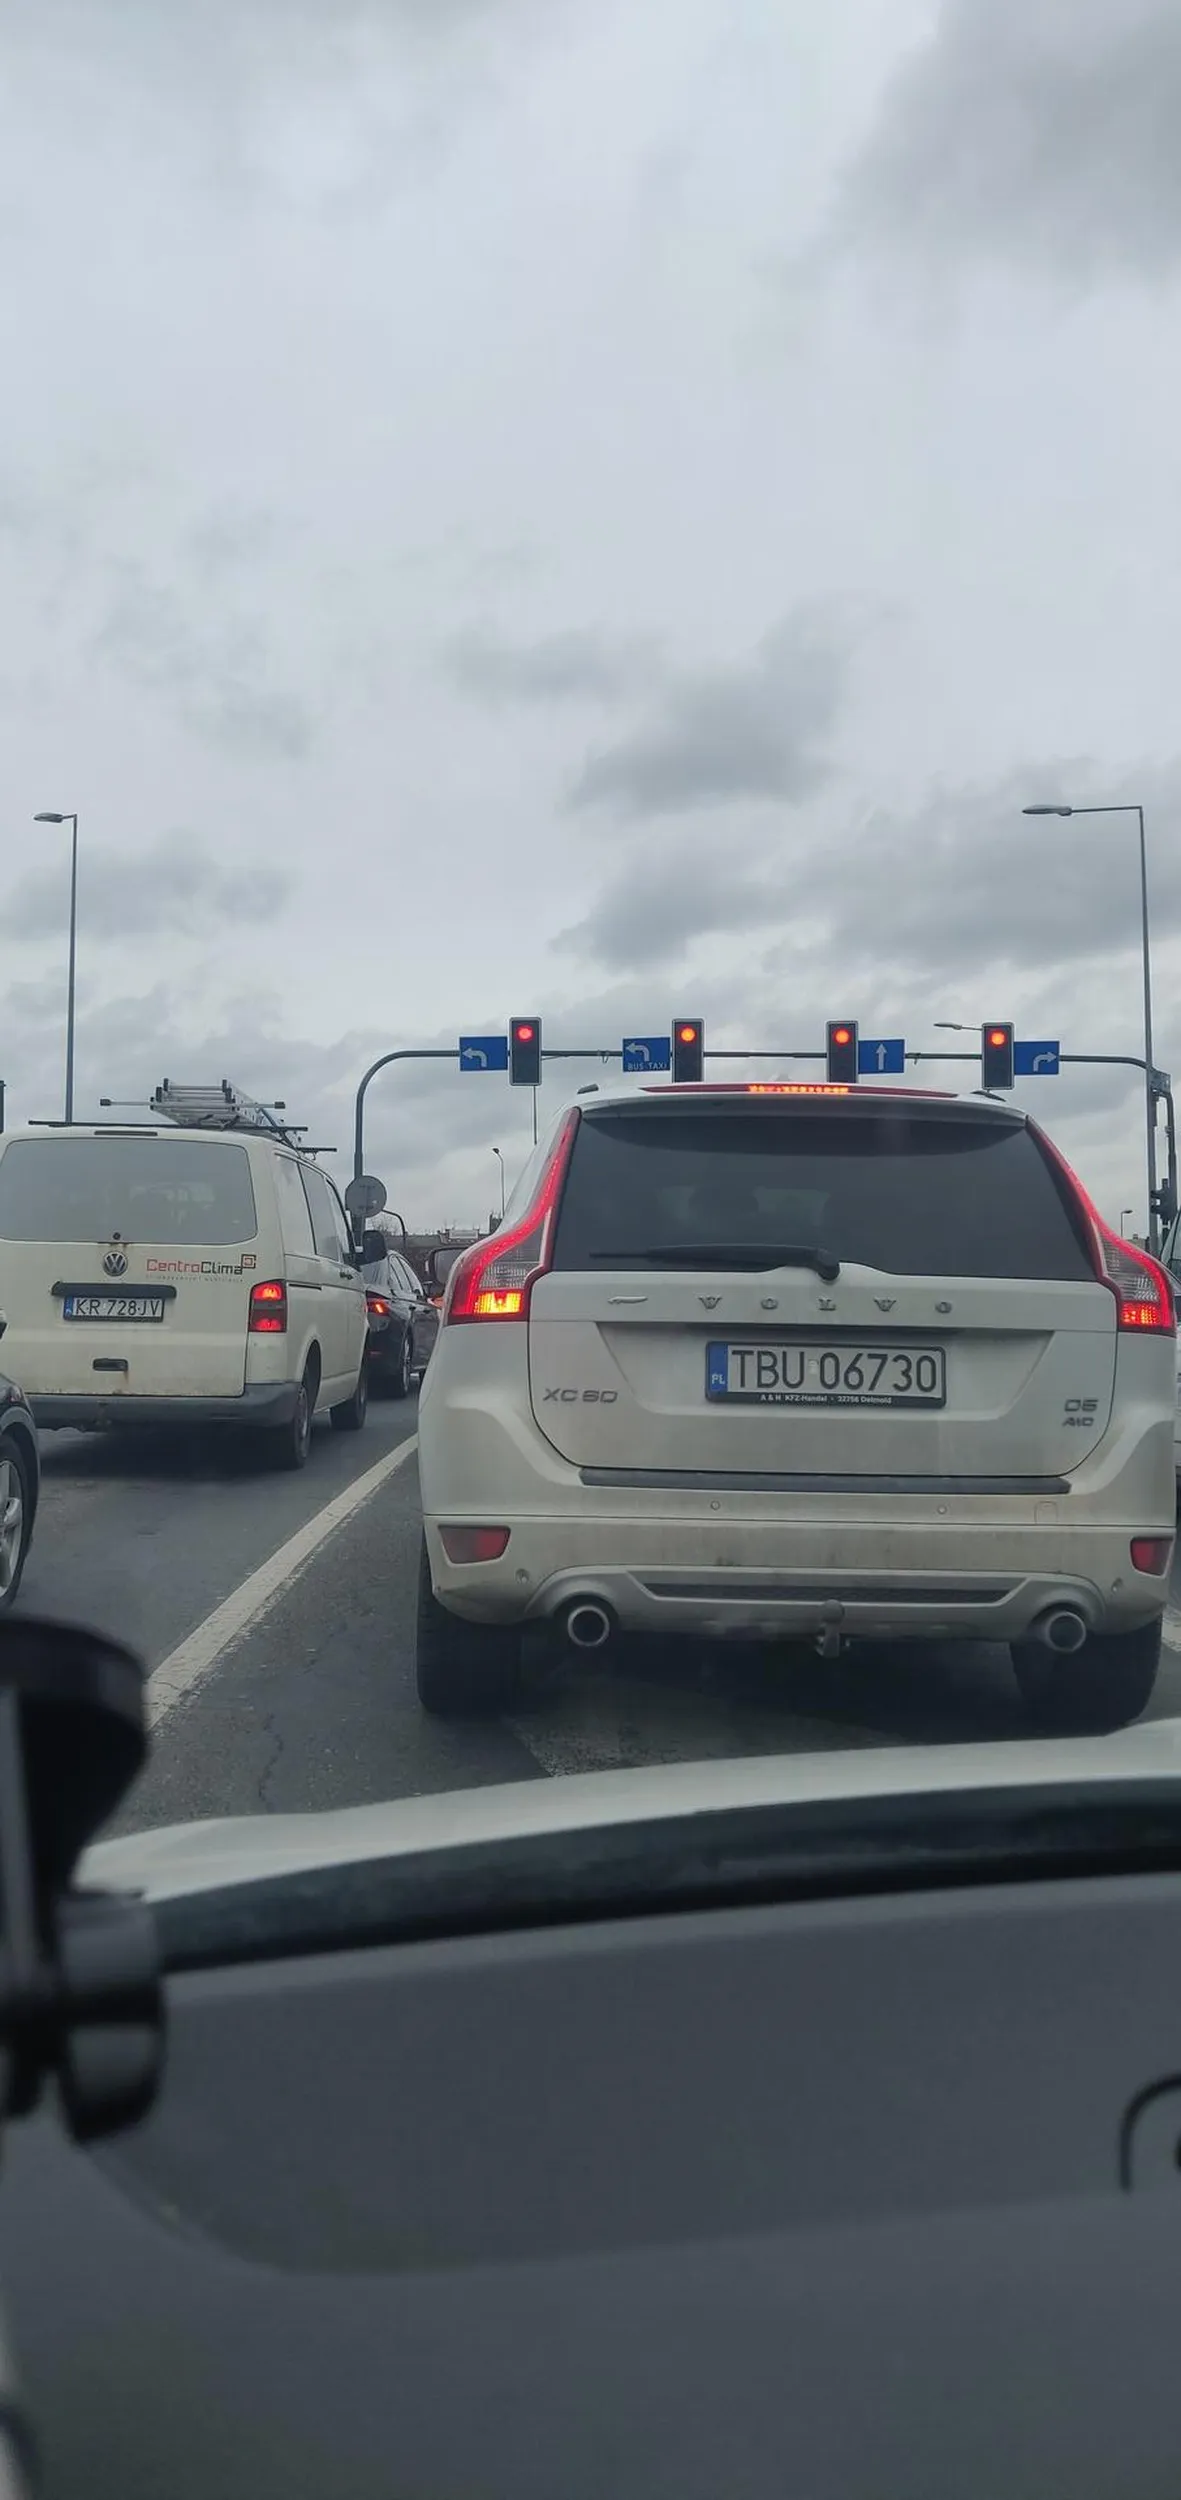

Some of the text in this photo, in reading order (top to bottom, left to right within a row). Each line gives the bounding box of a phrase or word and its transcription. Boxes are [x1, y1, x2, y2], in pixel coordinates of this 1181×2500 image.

[627, 1062, 667, 1071] BUS TAXI
[146, 1258, 243, 1275] CentroClima
[75, 1299, 161, 1316] KR 728JV
[699, 1297, 952, 1314] VOLVO
[711, 1373, 726, 1385] PL
[731, 1350, 937, 1393] TBU 06730
[1064, 1398, 1098, 1413] D5
